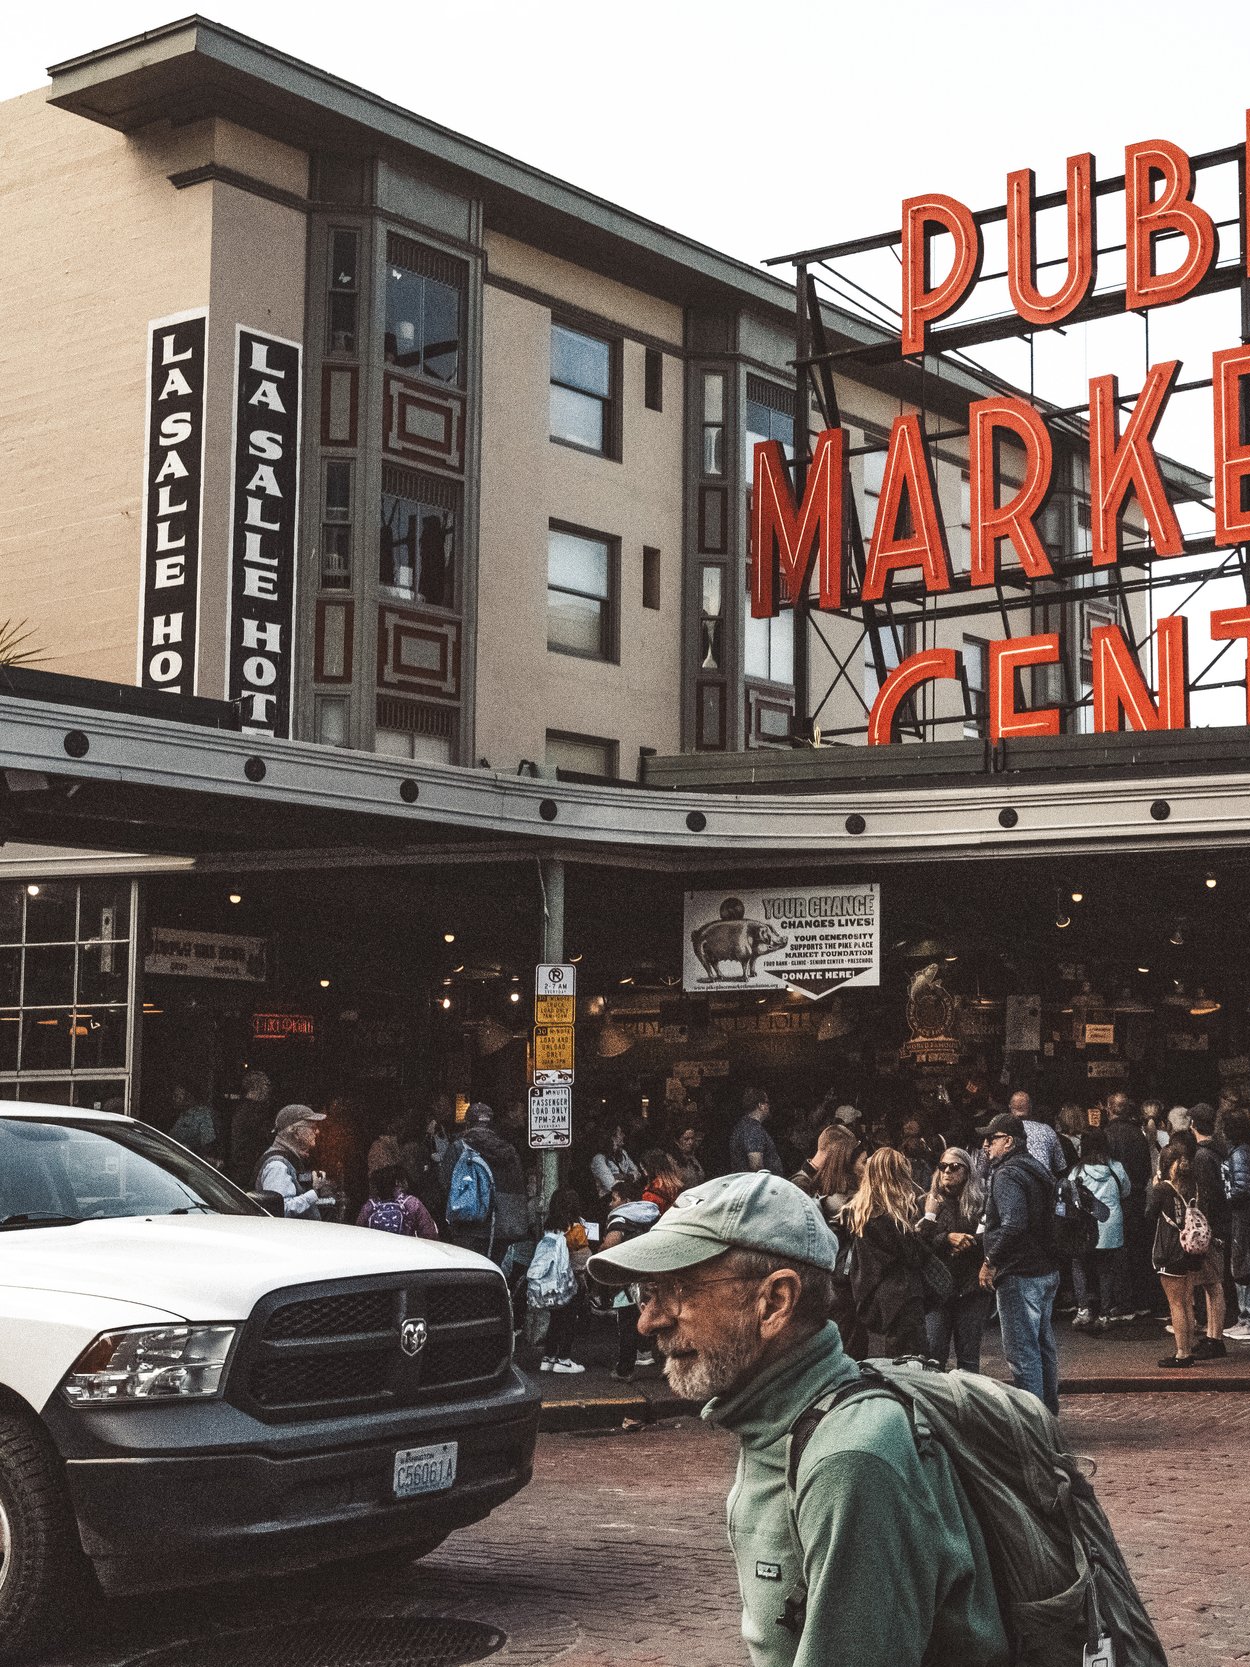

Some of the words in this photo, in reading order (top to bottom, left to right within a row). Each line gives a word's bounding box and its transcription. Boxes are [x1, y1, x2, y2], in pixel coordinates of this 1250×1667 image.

[157, 333, 193, 401] LA
[248, 341, 287, 414] LA
[154, 411, 193, 590] SALLE
[242, 430, 283, 601] SALLE
[149, 611, 184, 694] HO
[762, 897, 807, 920] YOUR
[808, 894, 875, 918] CHANGE
[780, 918, 835, 930] CHANGES
[837, 917, 875, 928] LIVES!
[794, 934, 818, 942] YOUR
[819, 932, 874, 941] GENEROSITY
[789, 943, 823, 951] SUPPORTS
[824, 942, 836, 950] THE
[853, 941, 873, 949] PLACE
[785, 951, 819, 959] MARKET
[820, 949, 873, 958] FOUNDATION
[781, 971, 823, 980] DONATE
[825, 970, 855, 979] HERE!
[541, 1043, 566, 1051] UNLOAD
[532, 1098, 567, 1106] PASSENGER
[552, 1106, 567, 1114] ONLY
[397, 1457, 453, 1489] C56061A
